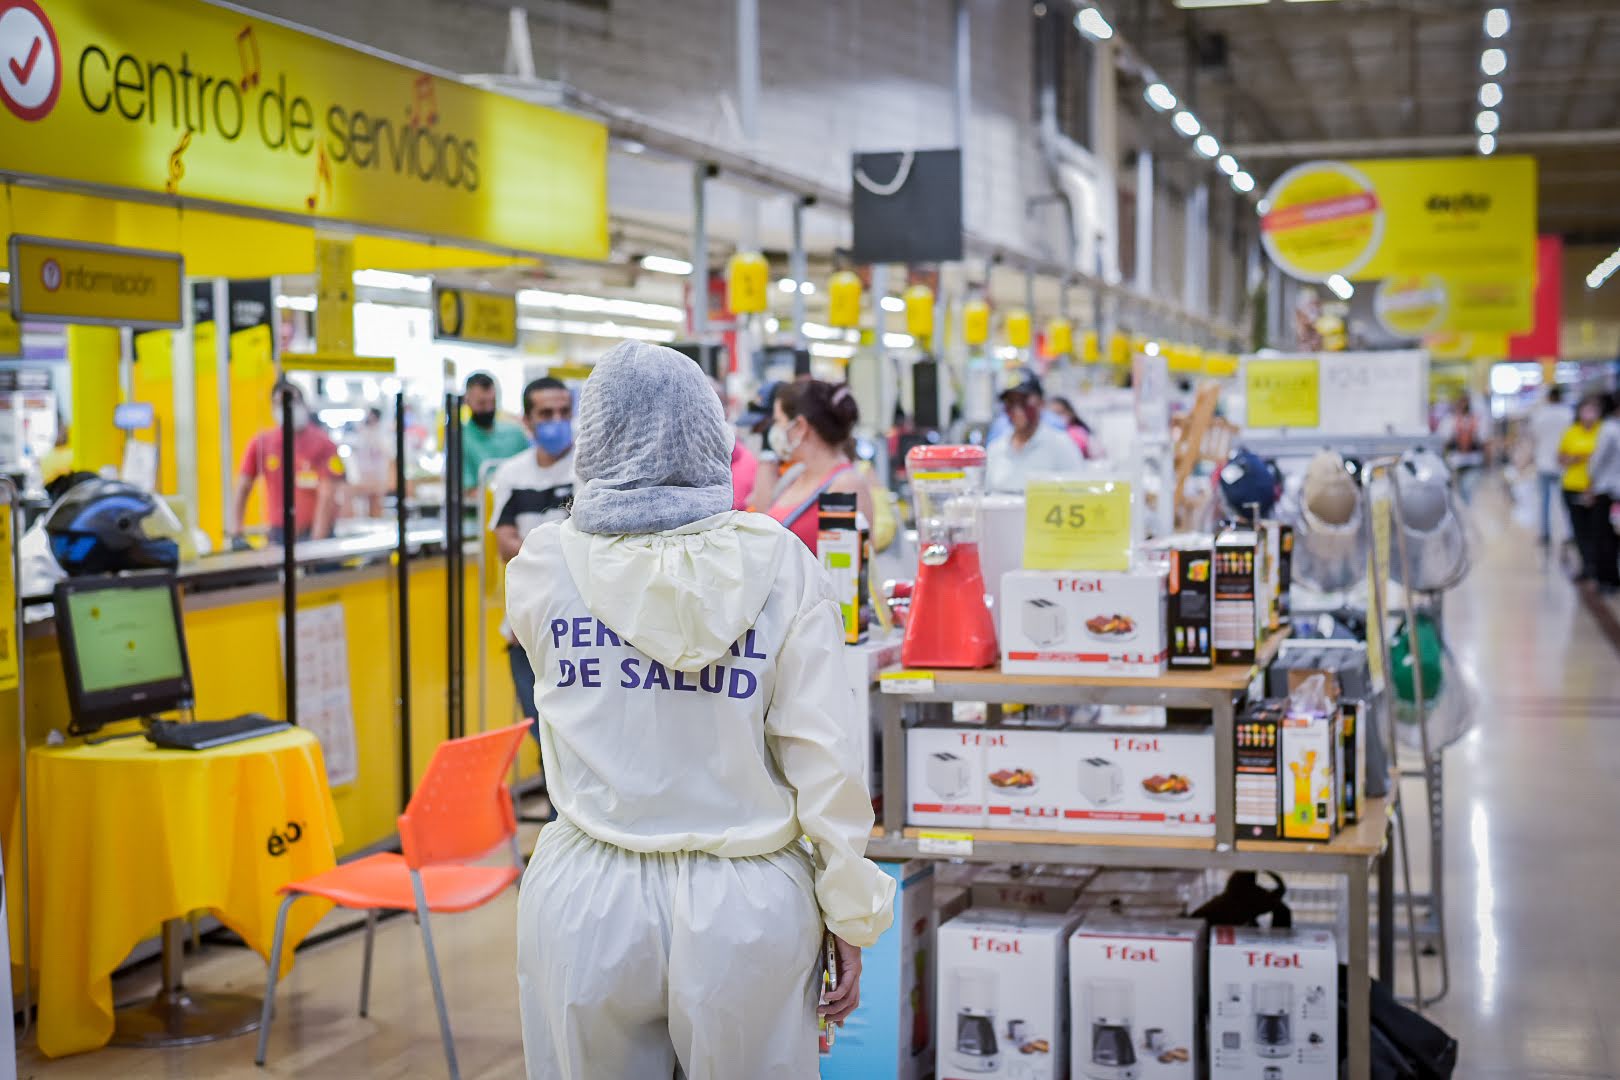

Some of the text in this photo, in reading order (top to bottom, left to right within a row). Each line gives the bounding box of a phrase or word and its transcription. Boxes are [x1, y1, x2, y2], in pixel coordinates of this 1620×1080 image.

[79, 45, 479, 192] centro de servicios
[1044, 504, 1085, 528] 45
[551, 616, 767, 660] PERL
[556, 658, 757, 699] DE SALUD
